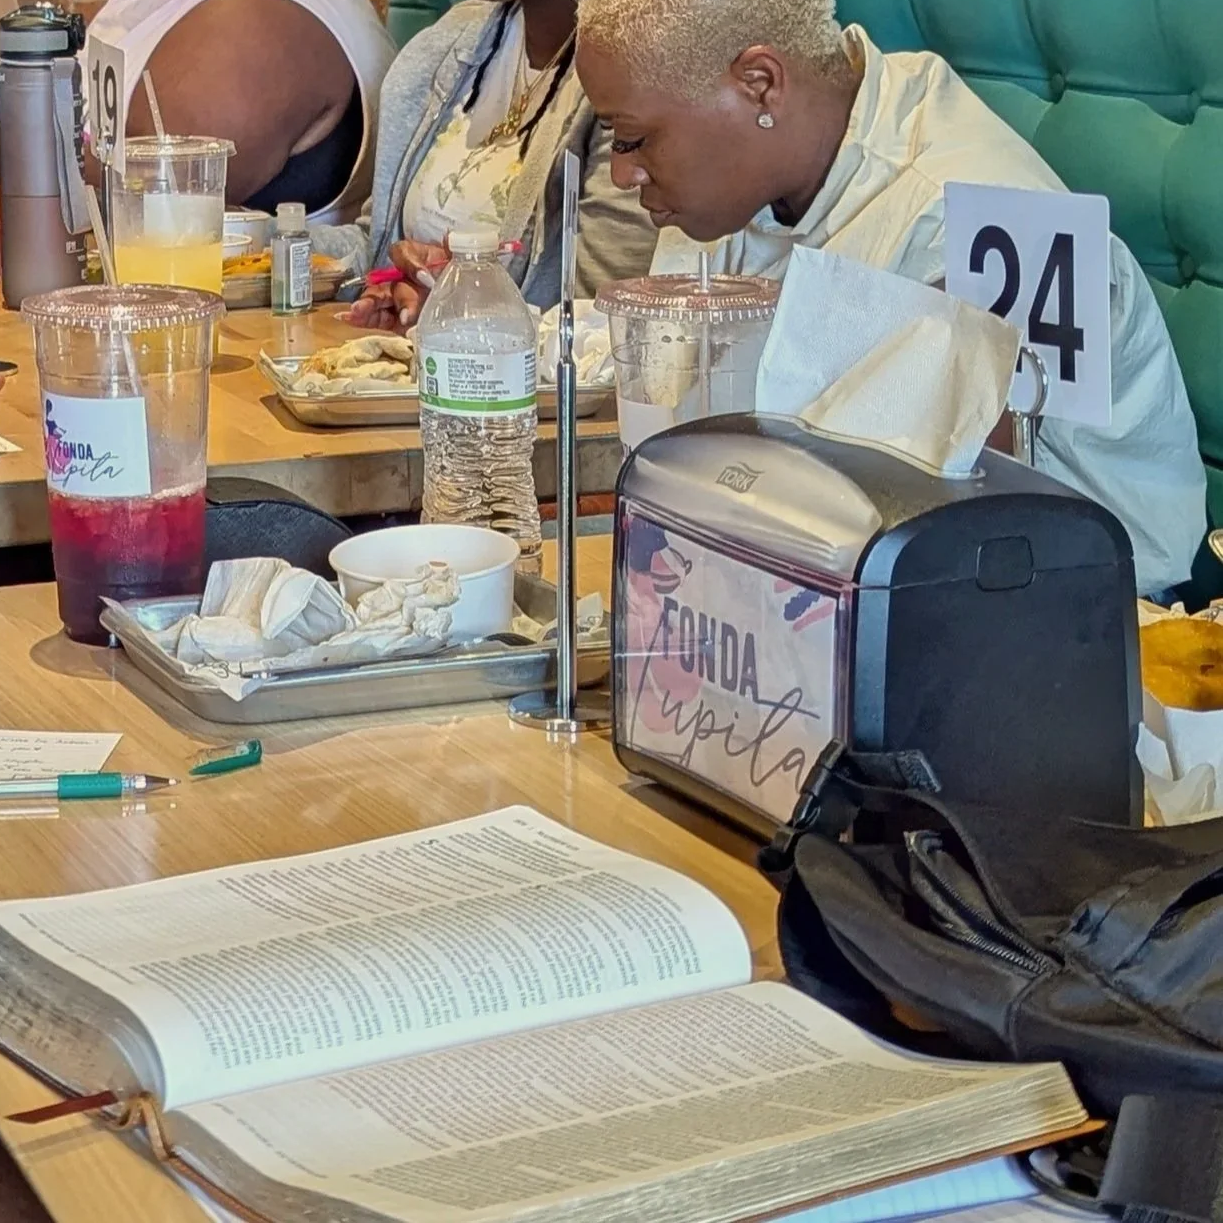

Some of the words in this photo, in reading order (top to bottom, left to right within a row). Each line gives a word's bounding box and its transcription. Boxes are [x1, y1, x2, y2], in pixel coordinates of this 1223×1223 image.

[92, 59, 117, 150] 19
[57, 439, 95, 461] FONDA
[719, 467, 753, 491] TORK
[661, 595, 760, 703] FONDA
